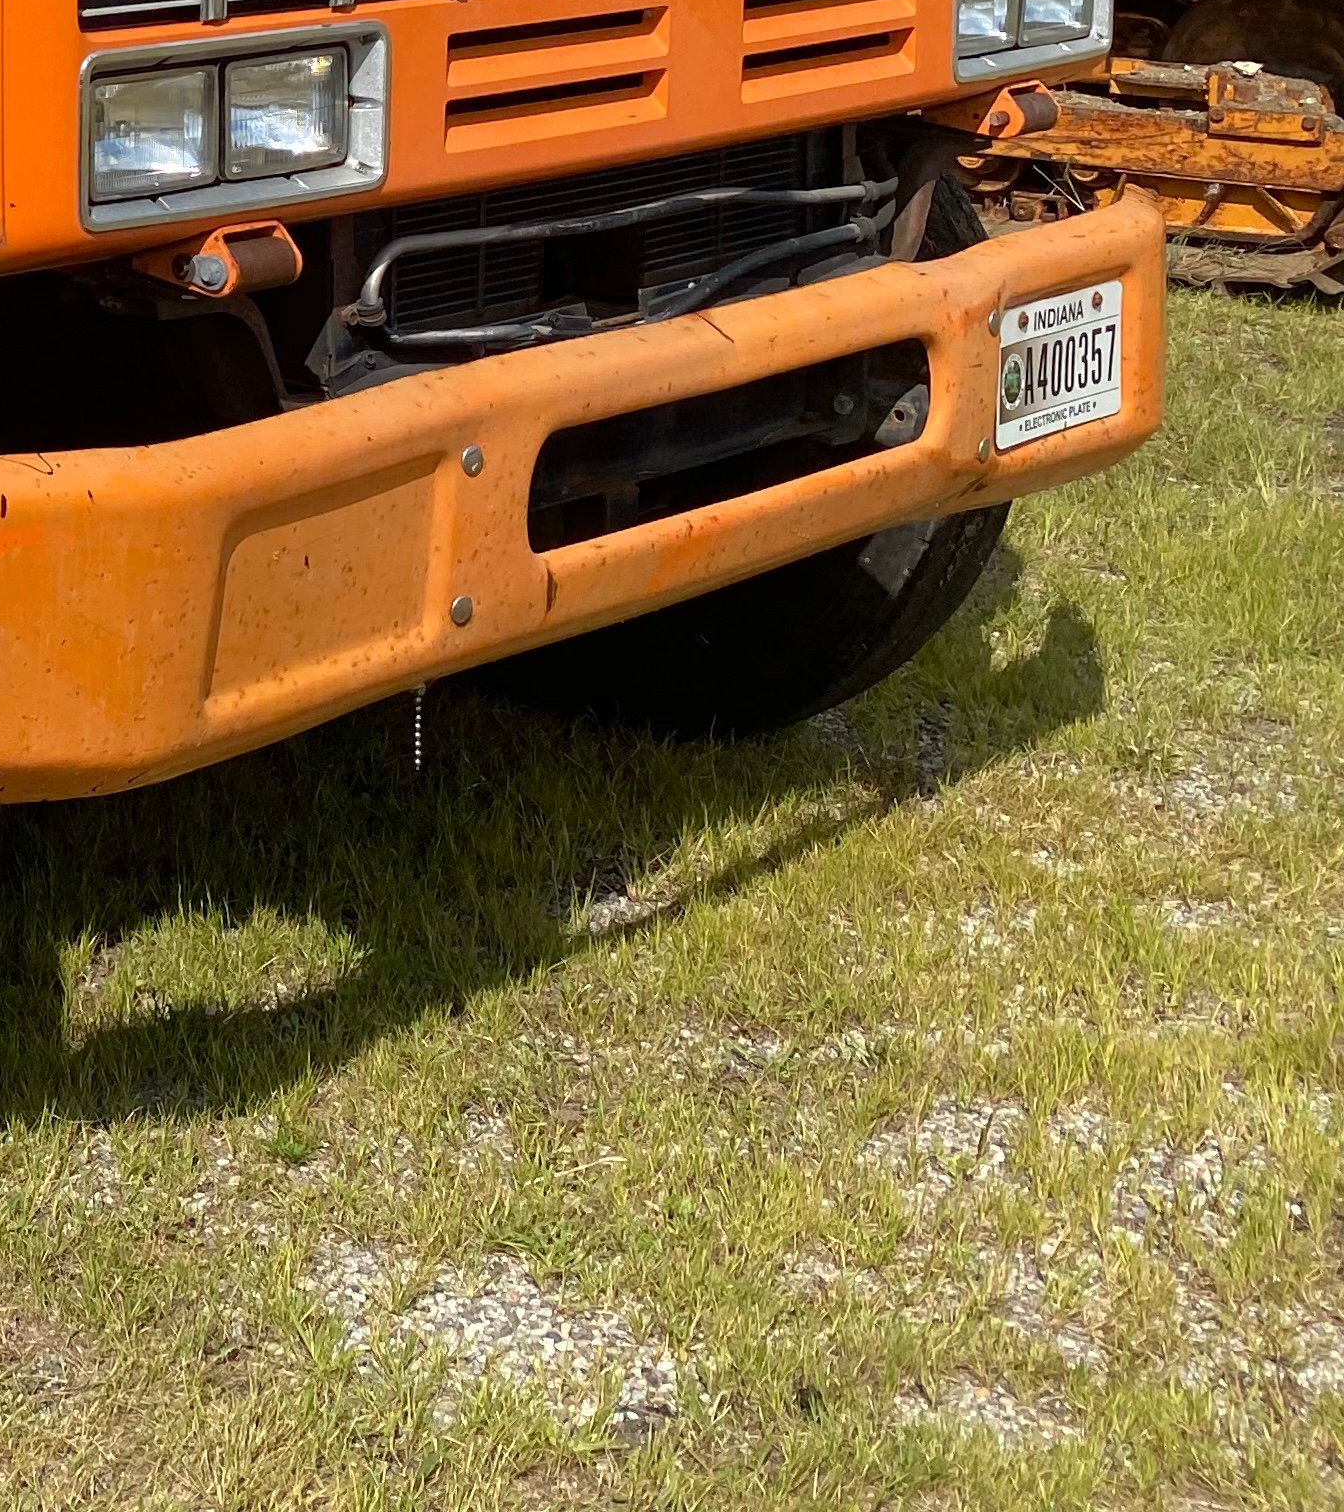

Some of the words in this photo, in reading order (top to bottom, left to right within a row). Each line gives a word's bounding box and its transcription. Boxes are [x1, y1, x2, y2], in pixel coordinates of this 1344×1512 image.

[1033, 299, 1084, 332] INDIANA
[1024, 324, 1116, 406] A400357
[1024, 408, 1068, 432] ELECTRONIC
[1068, 401, 1092, 418] PLATE
